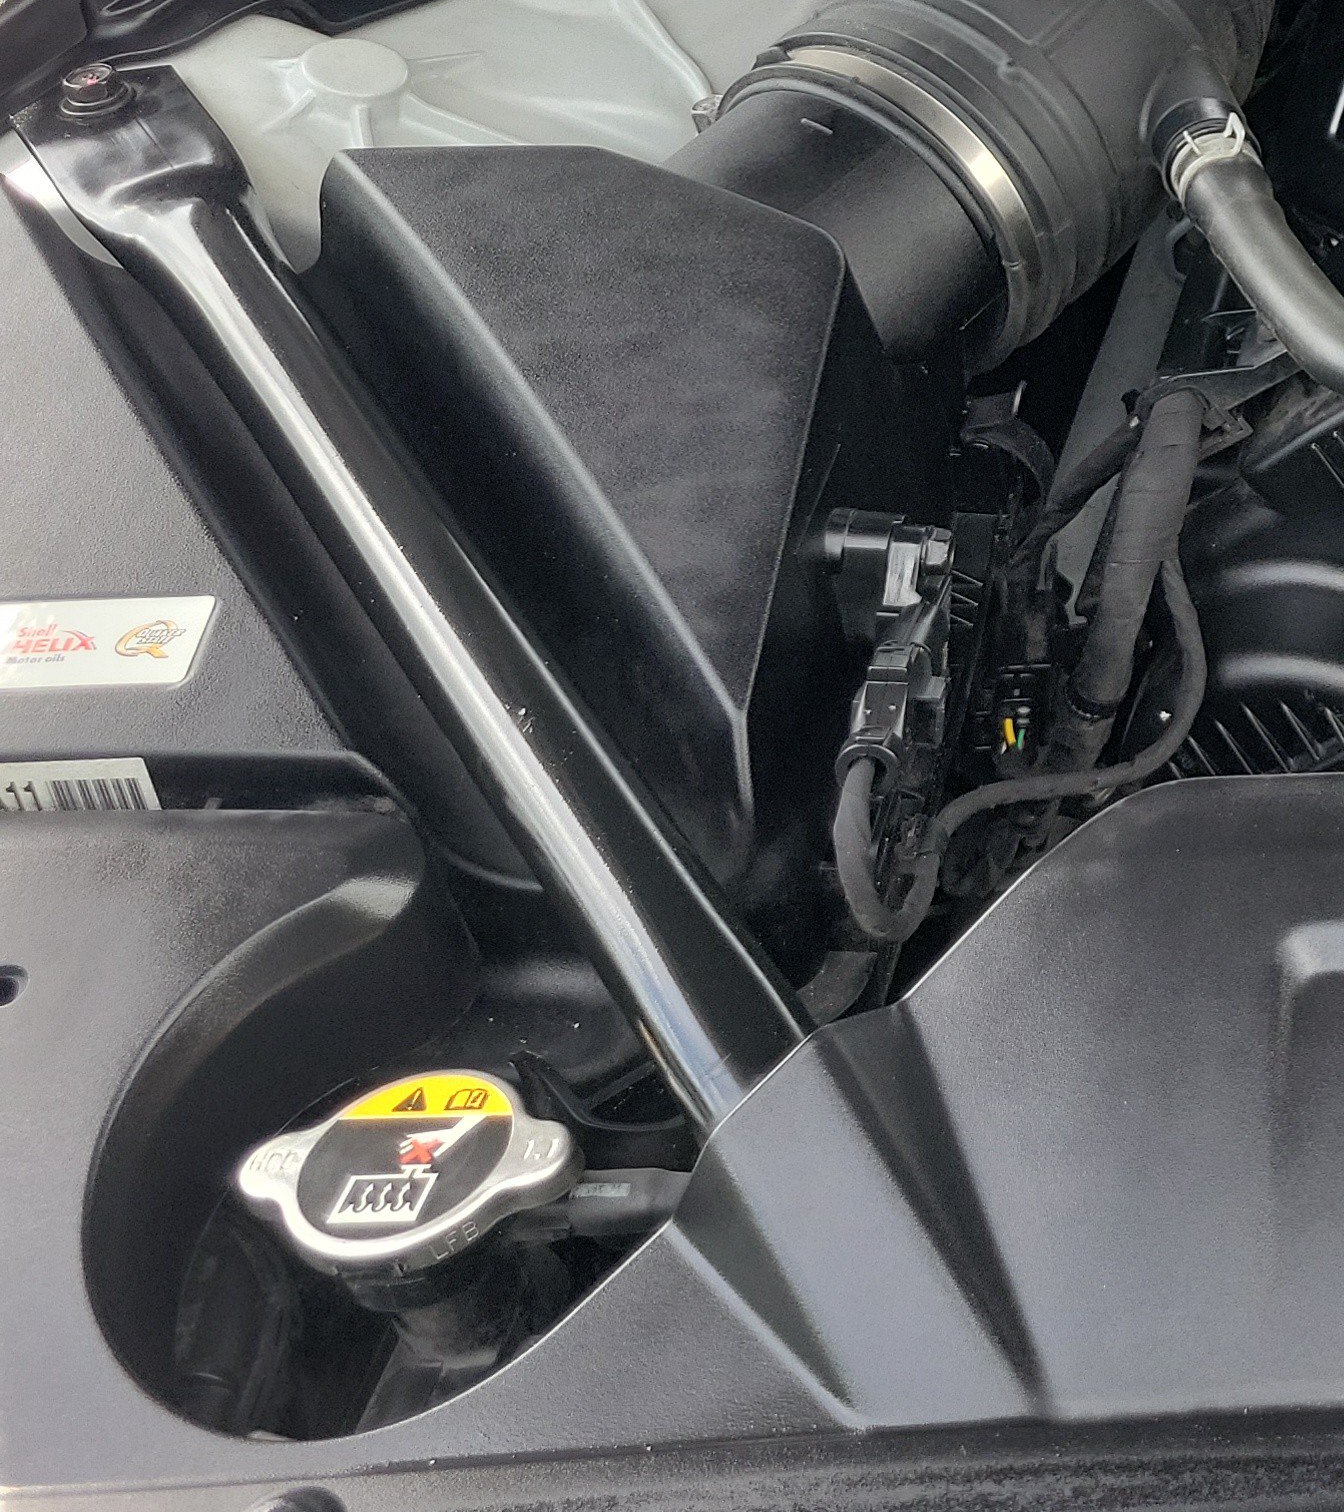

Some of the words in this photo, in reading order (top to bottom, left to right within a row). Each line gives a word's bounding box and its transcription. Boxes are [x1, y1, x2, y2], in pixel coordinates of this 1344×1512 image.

[8, 630, 97, 654] HELIX
[0, 780, 44, 811] 11
[428, 1222, 482, 1260] LFB
